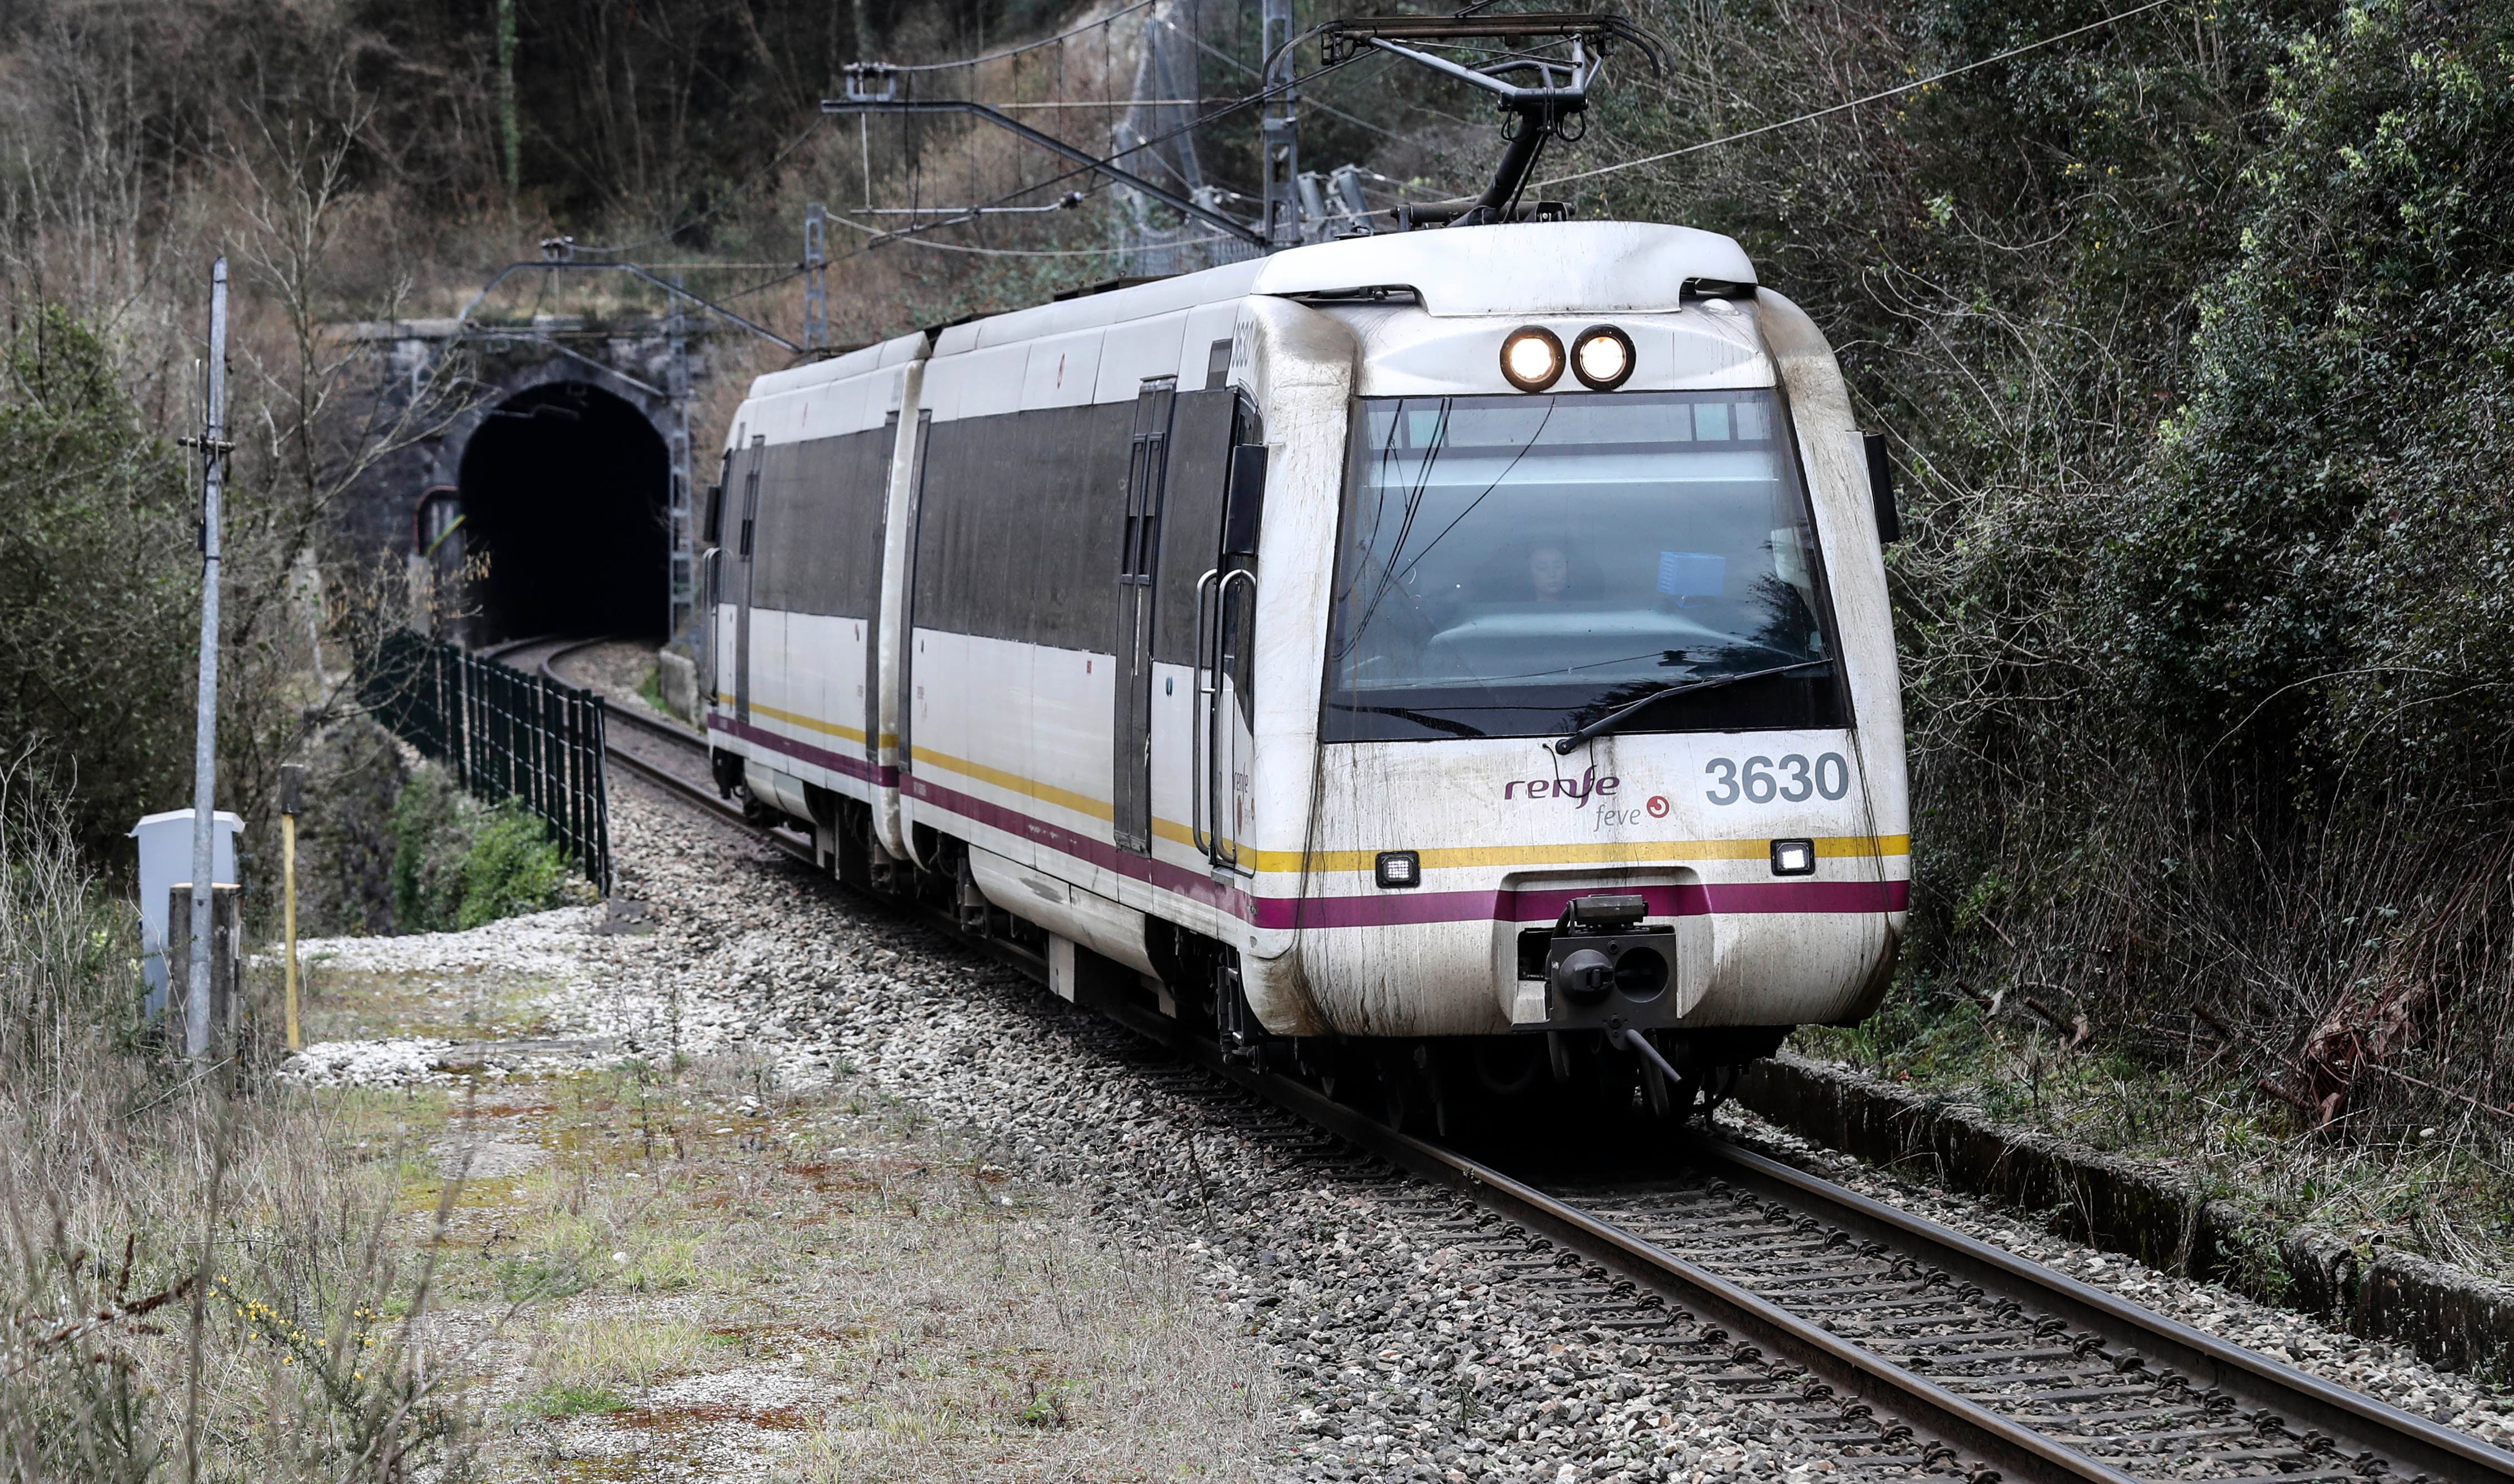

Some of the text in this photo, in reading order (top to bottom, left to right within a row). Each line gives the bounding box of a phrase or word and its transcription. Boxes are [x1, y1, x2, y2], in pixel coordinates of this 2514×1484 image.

[1232, 321, 1253, 368] 3630
[1233, 762, 1248, 804] renfe
[1504, 765, 1620, 809] renfe
[1705, 752, 1849, 806] 3630
[1593, 804, 1641, 832] feve
